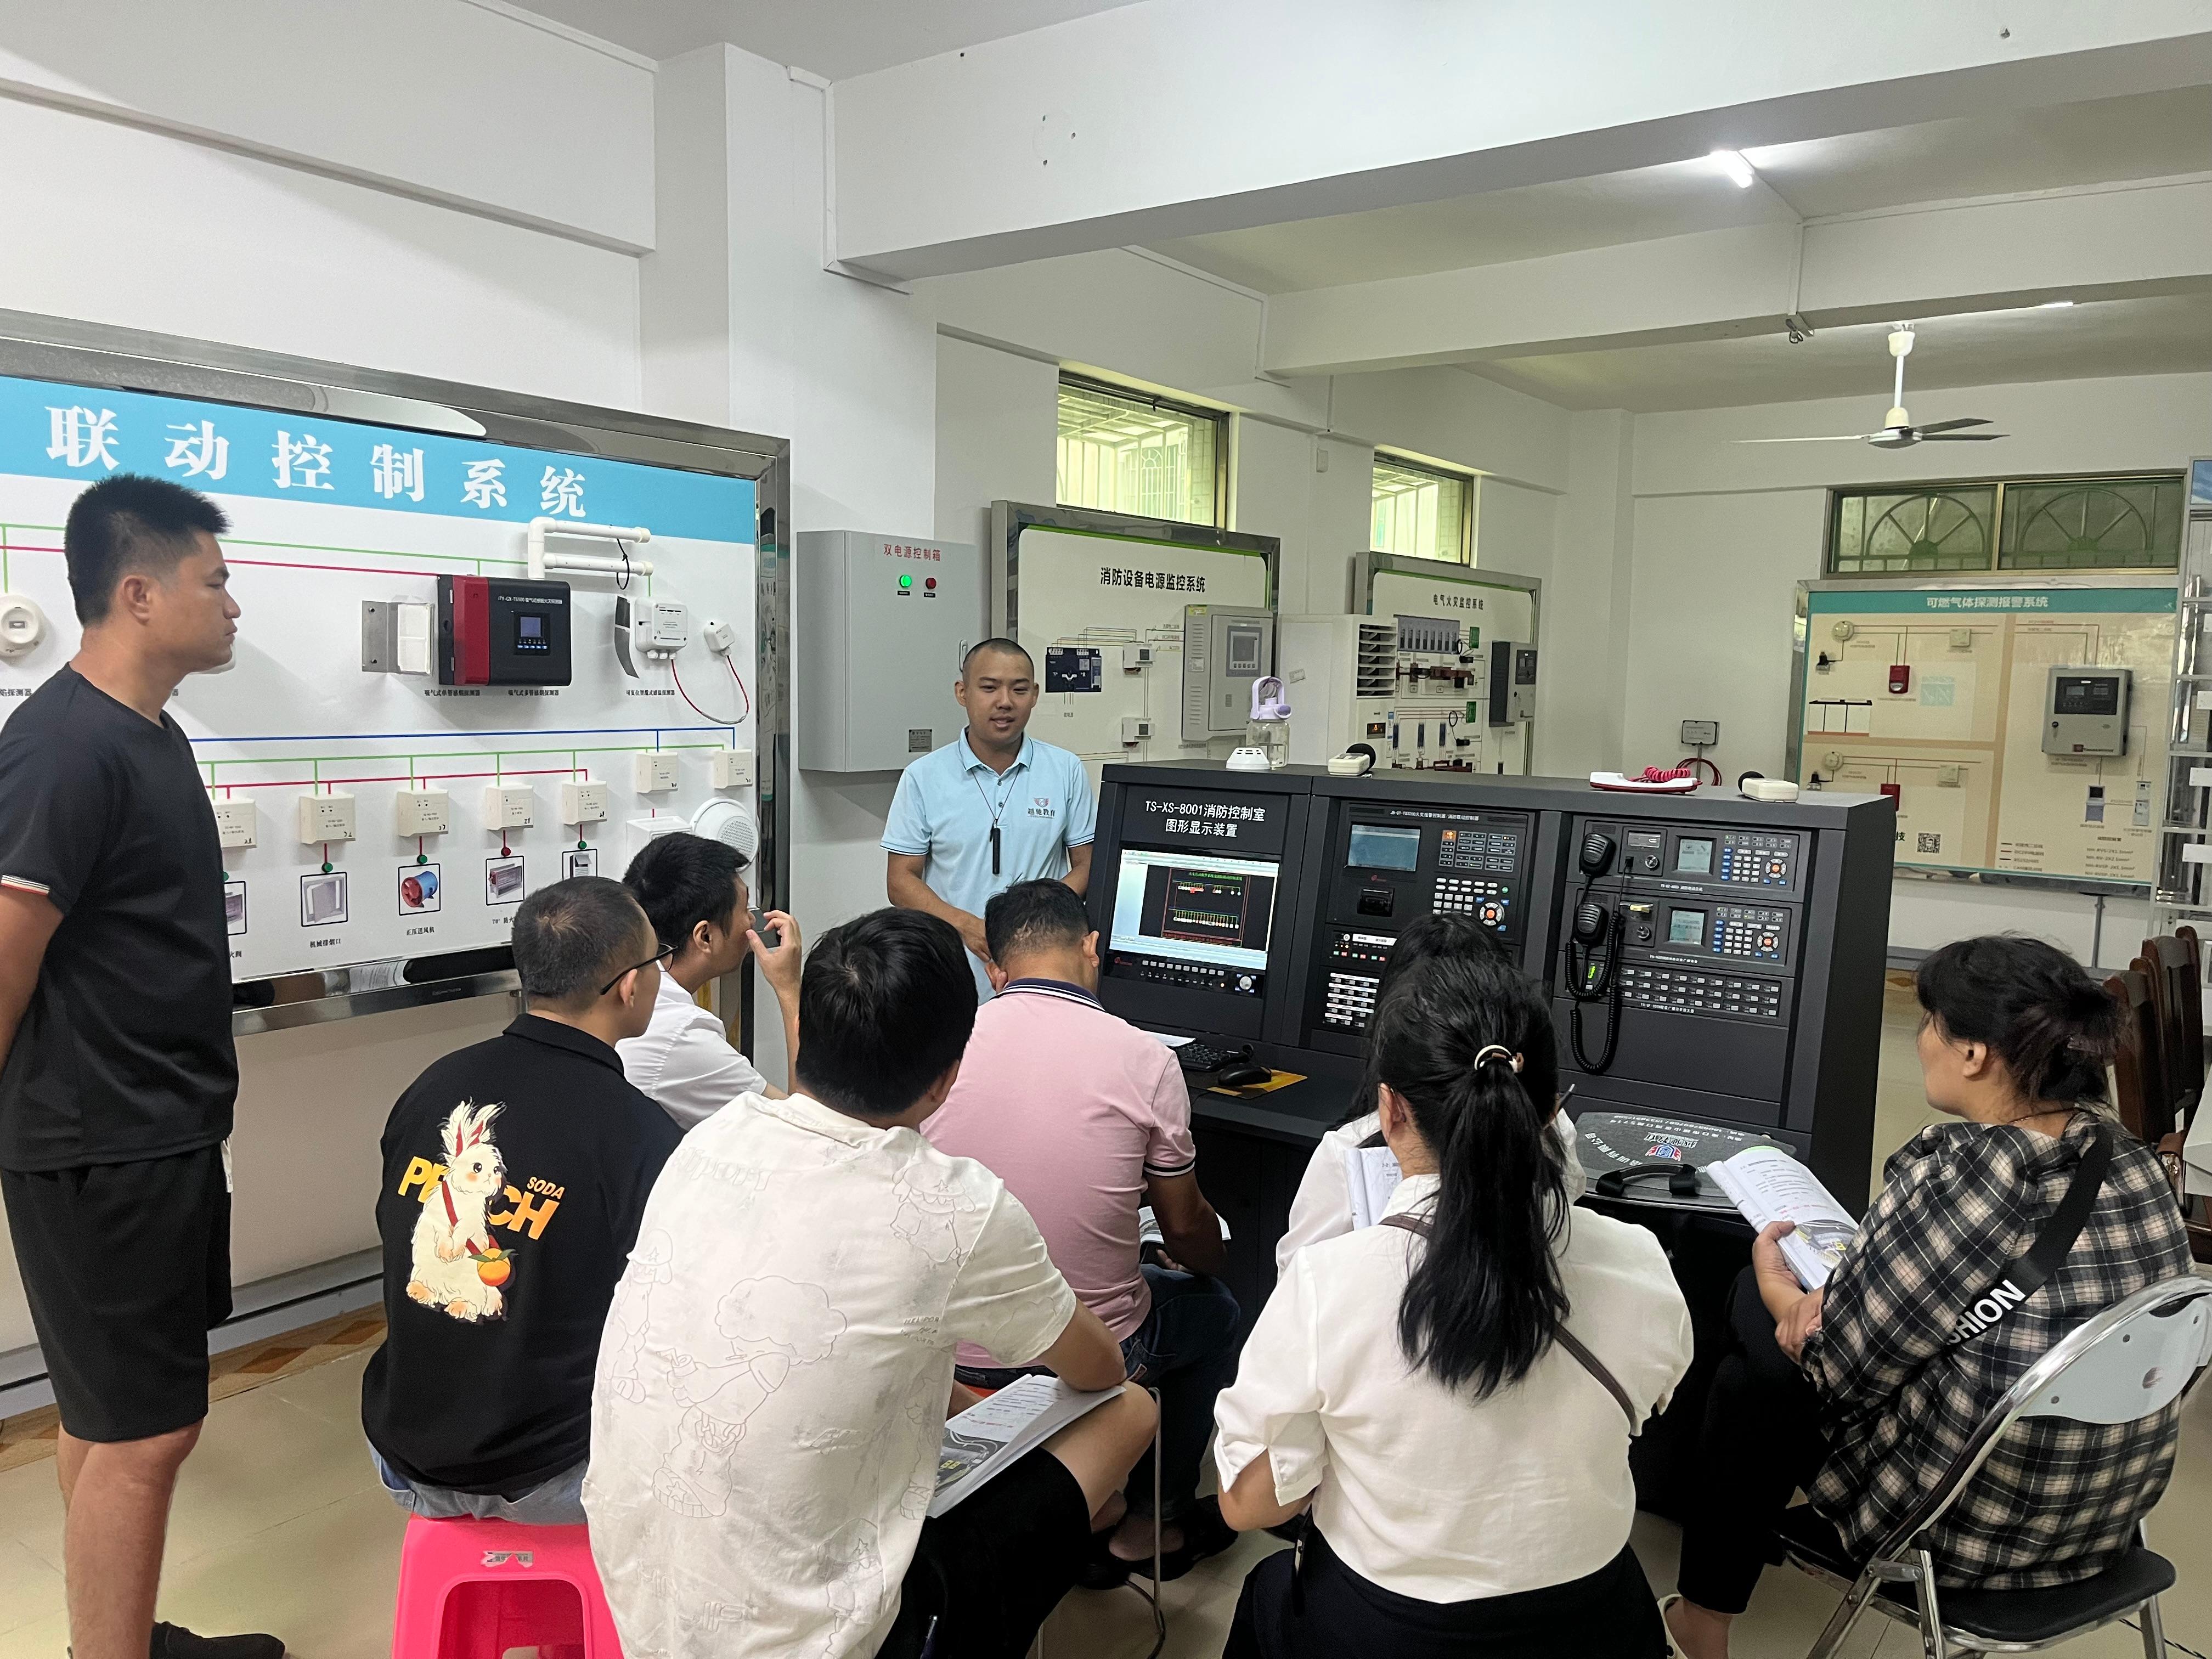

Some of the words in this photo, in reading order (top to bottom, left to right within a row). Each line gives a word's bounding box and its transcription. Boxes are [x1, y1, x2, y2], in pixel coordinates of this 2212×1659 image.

[45, 405, 586, 518] 联动控制系统
[884, 544, 940, 561] 双电源控制箱
[1100, 567, 1205, 592] 消防设备电源监控系统
[1434, 594, 1483, 610] 电气火灾监控系统
[1927, 596, 2049, 608] 可燃气体探测报警系统
[1145, 800, 1266, 822] TS-XS-8001消防控制室
[1165, 819, 1238, 838] 图形显示装置
[406, 926, 435, 936] 正压送风机
[309, 939, 342, 949] 机械排烟口
[527, 1176, 566, 1199] SODA
[398, 1156, 560, 1240] PECH
